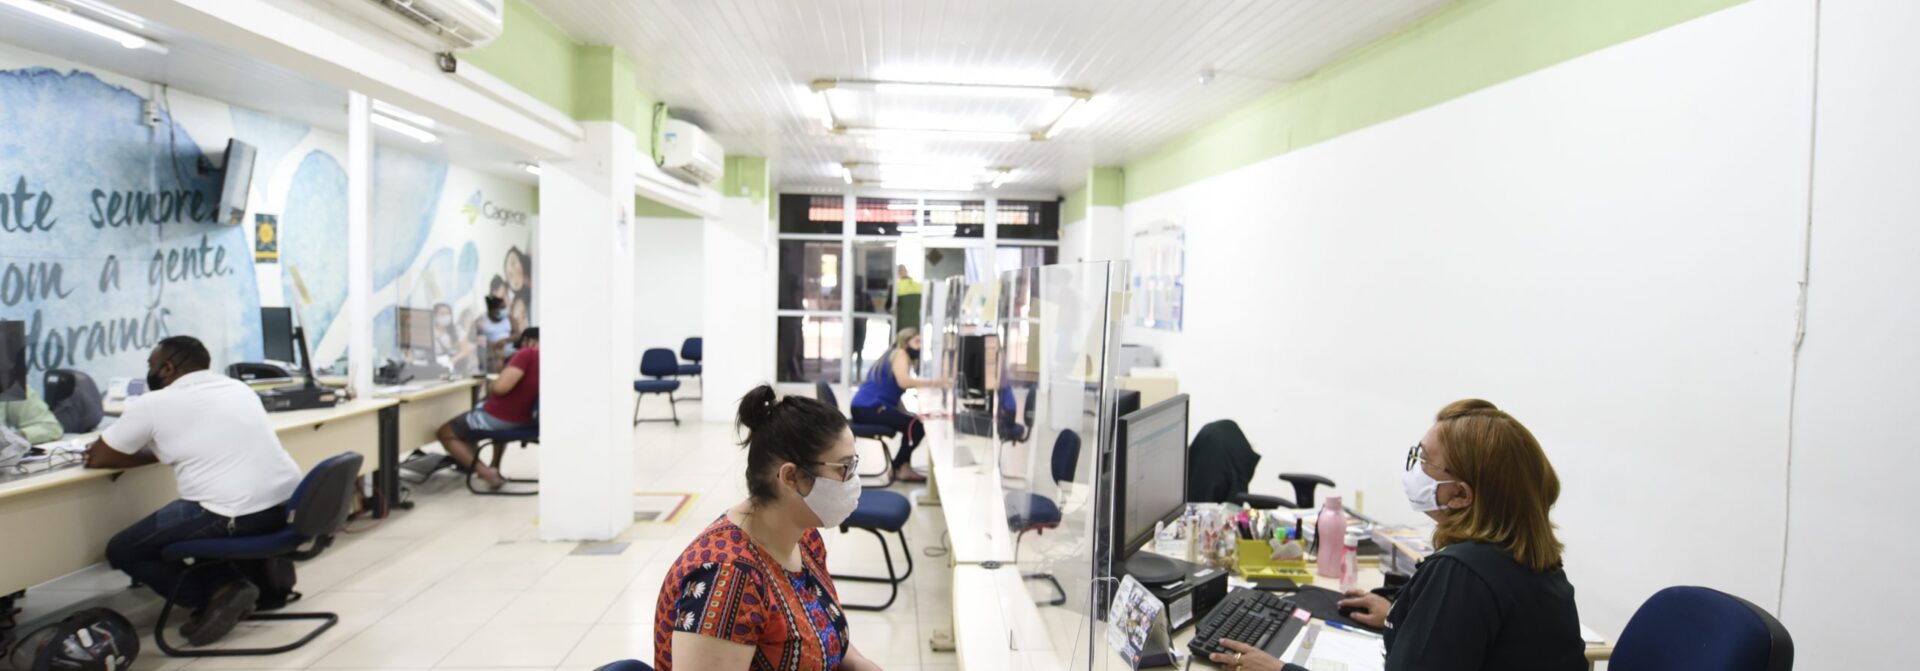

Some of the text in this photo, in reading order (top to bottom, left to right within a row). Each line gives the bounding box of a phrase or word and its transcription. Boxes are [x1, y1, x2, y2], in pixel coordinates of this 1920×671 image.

[99, 254, 121, 293] a
[146, 233, 235, 310] gente.
[2, 309, 171, 372] doramos
